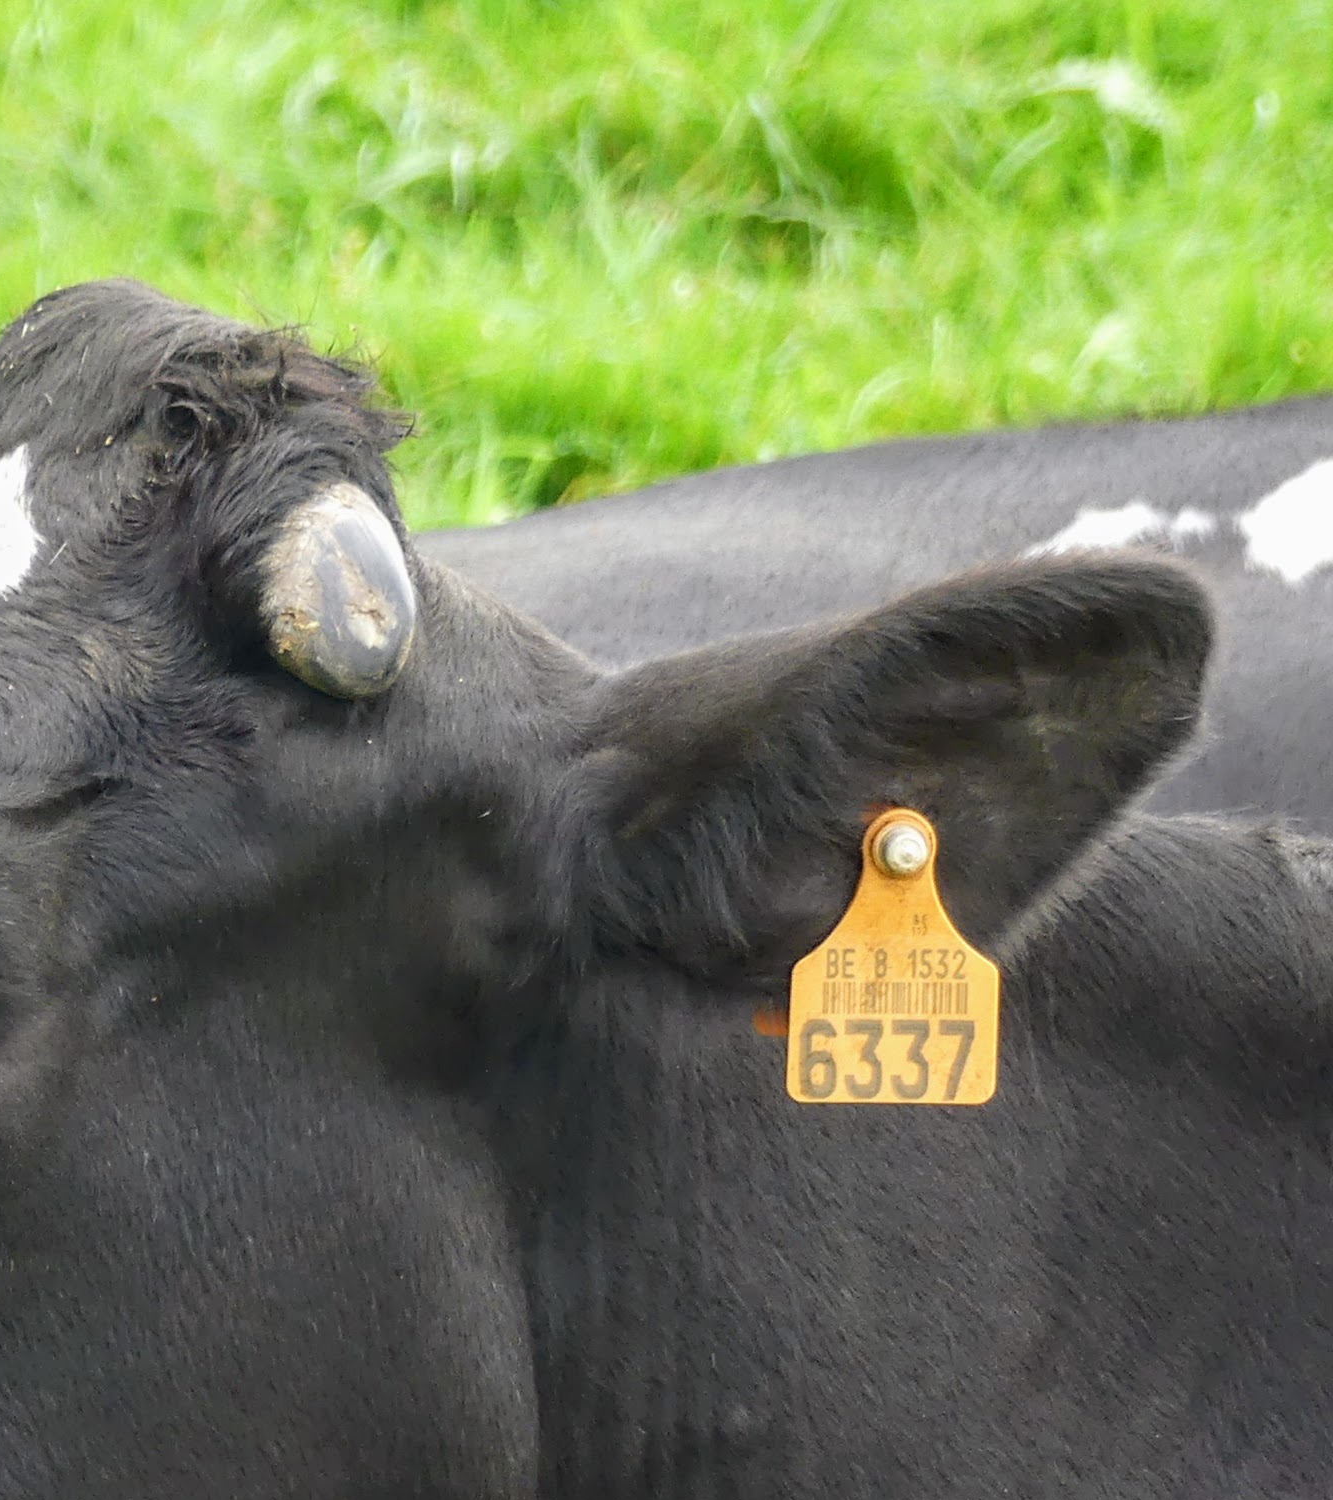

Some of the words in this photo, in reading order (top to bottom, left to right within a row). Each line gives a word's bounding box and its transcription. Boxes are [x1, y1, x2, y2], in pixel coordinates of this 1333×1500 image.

[825, 948, 855, 979] BE
[874, 948, 888, 979] 8
[907, 948, 967, 980] 1532
[798, 1018, 975, 1101] 6337
